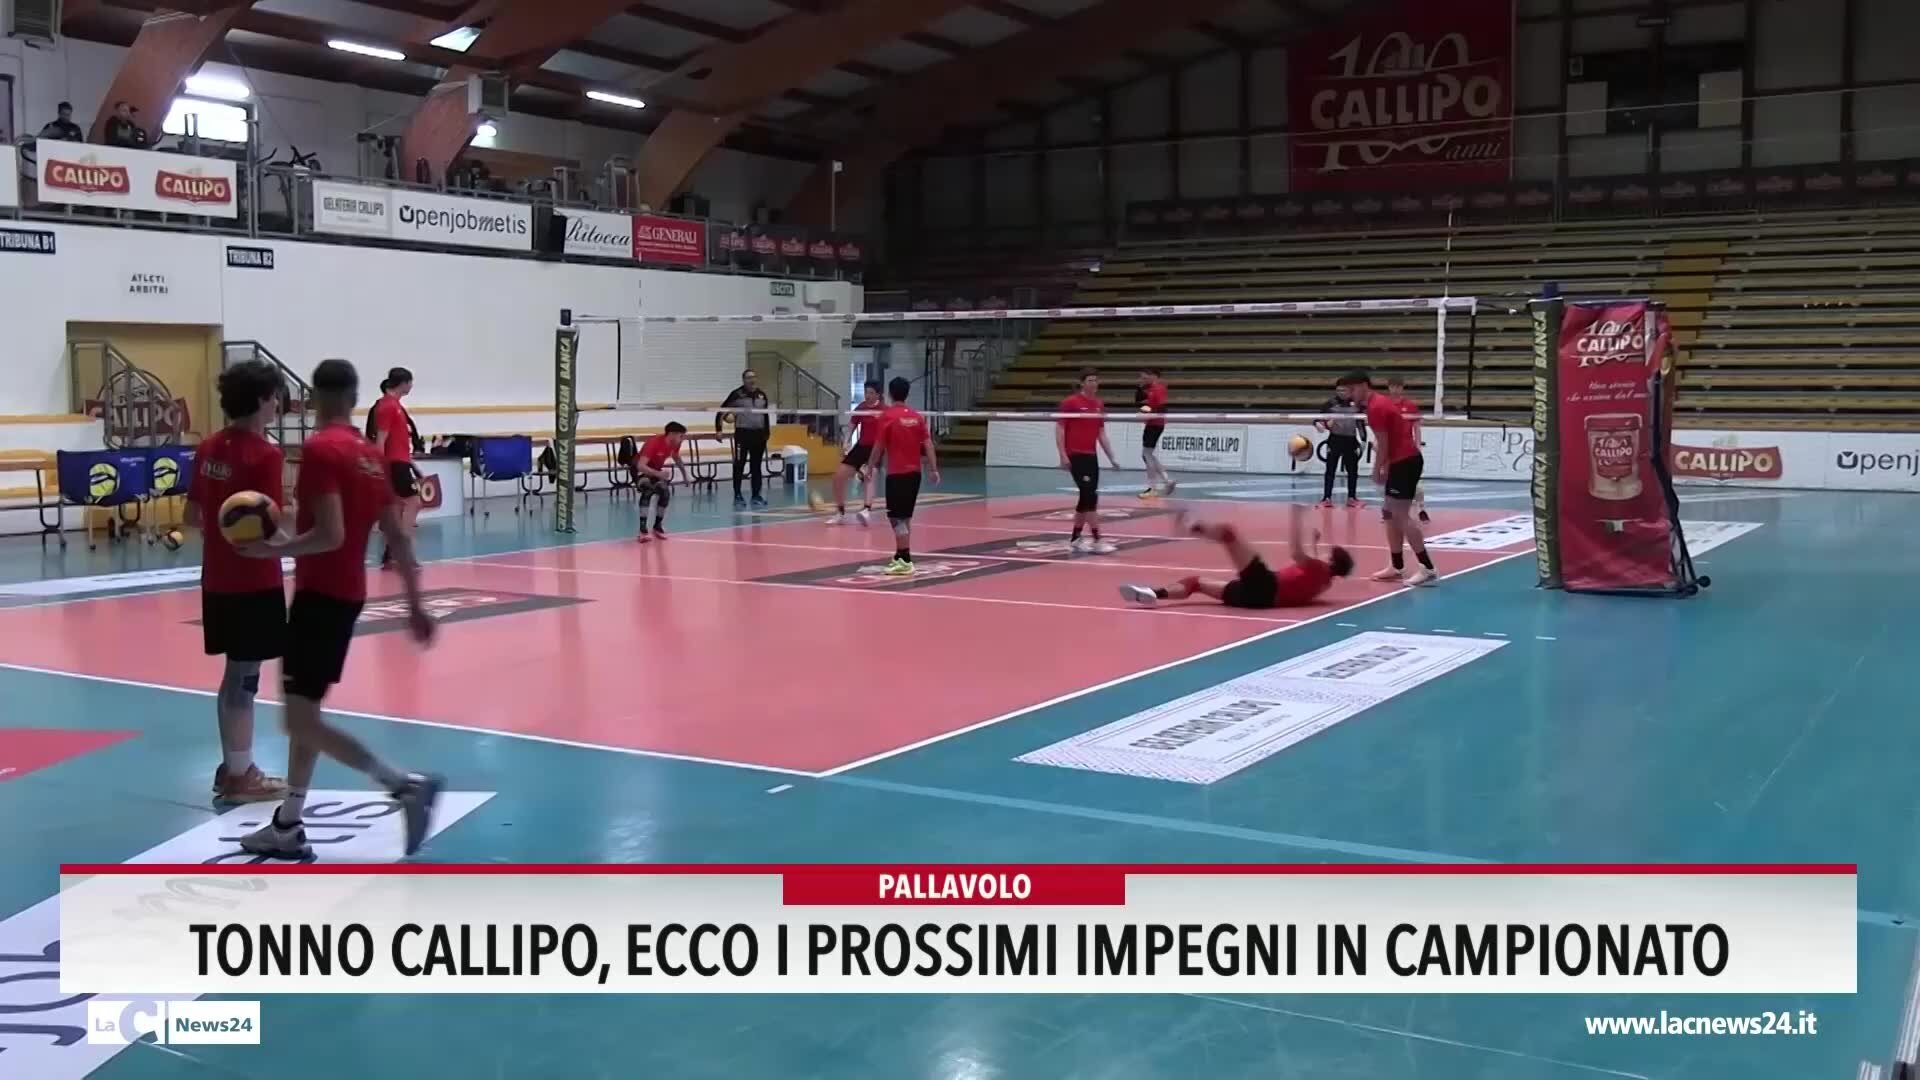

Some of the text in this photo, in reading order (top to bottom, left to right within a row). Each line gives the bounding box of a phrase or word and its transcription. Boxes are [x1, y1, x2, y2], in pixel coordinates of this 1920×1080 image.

[1311, 73, 1503, 130] CALLIPO
[52, 167, 124, 188] CALLIPO
[161, 177, 226, 198] CALLIPO
[0, 232, 42, 250] TRIBUNA
[565, 216, 632, 246] Ritocca
[652, 226, 697, 245] GENERALI
[229, 249, 262, 265] TRIBUNA
[131, 273, 165, 283] ATLETI
[129, 285, 168, 294] ARBITRI
[1535, 310, 1547, 369] BANCA
[1576, 333, 1645, 353] CALLIPO
[560, 337, 571, 380] BANCA
[559, 385, 570, 432] CREDEM
[1535, 376, 1548, 443] CREDEM
[1161, 435, 1240, 452] GELATERIA CALLIPO
[559, 439, 569, 482] BANCA
[1674, 450, 1774, 473] CALLIPO
[1535, 452, 1547, 510] BANCA
